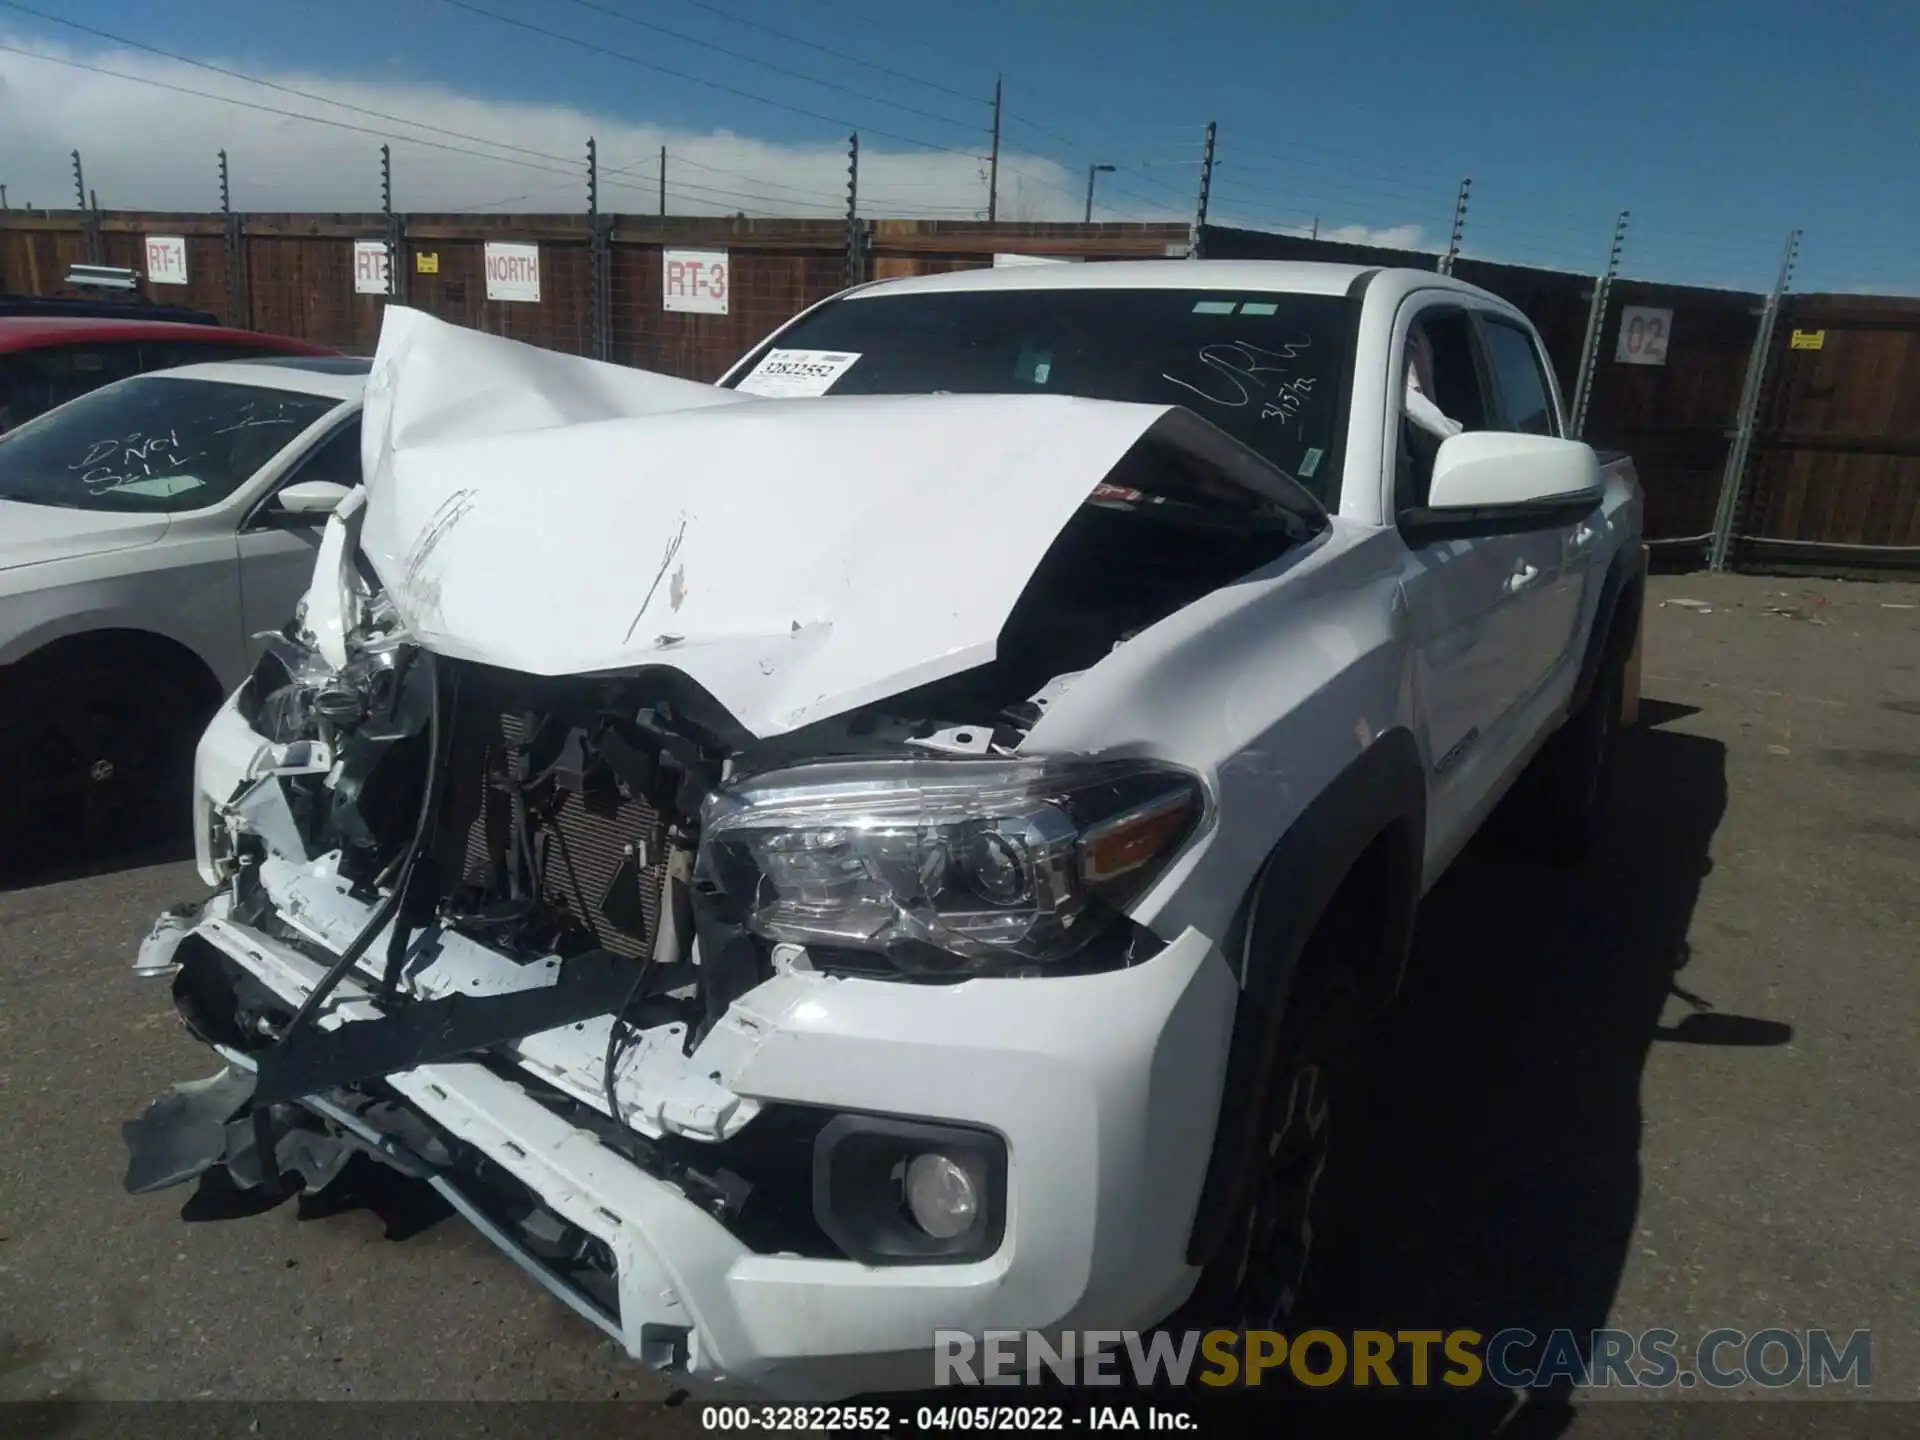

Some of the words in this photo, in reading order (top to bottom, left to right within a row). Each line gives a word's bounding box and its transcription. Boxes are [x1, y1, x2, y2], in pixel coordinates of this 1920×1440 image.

[148, 243, 184, 273] RT-1
[487, 256, 537, 283] NORTH
[667, 261, 726, 298] RT-3
[1627, 315, 1663, 355] 02
